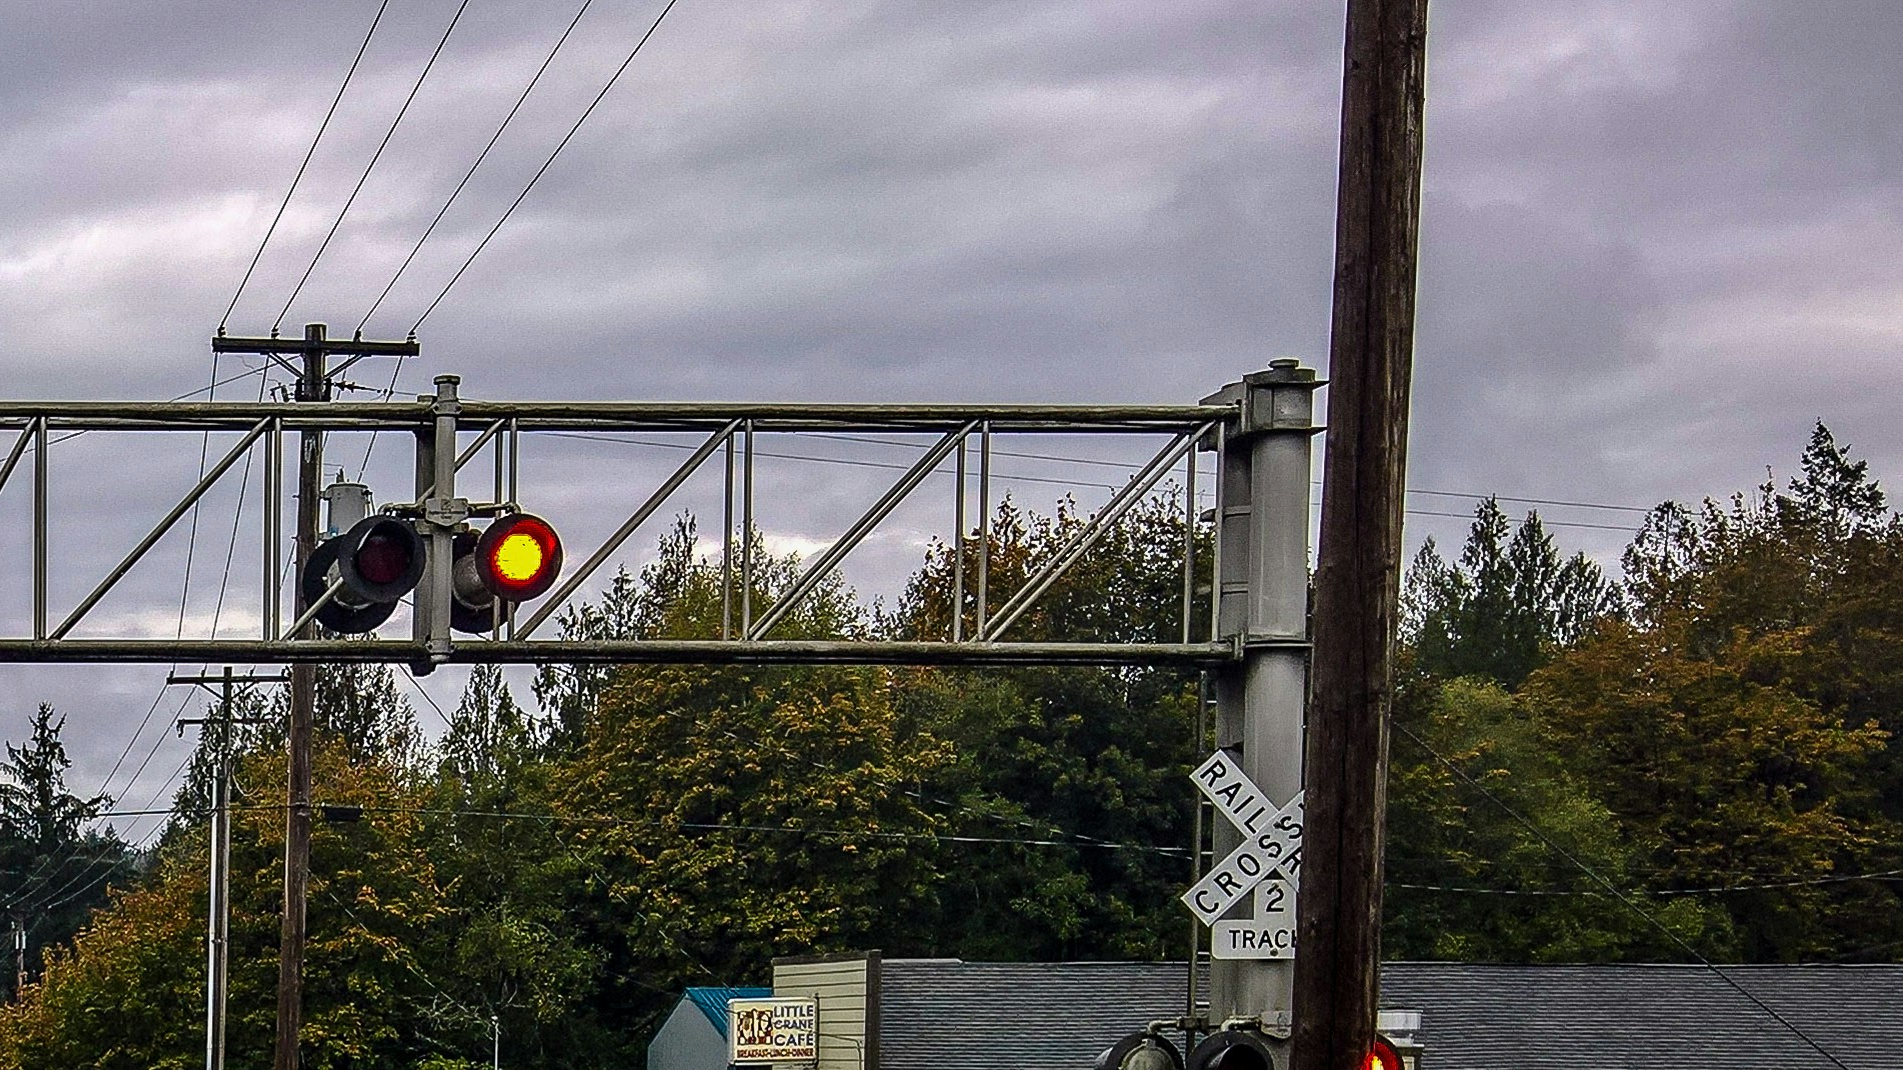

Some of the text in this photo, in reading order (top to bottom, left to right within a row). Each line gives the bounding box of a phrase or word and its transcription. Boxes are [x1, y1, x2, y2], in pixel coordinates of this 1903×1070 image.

[1194, 802, 1303, 914] CROSS
[1265, 886, 1285, 913] 2
[774, 1004, 814, 1018] LITTLE
[774, 1019, 814, 1030] CRANE
[774, 1031, 814, 1046] CAFÉ
